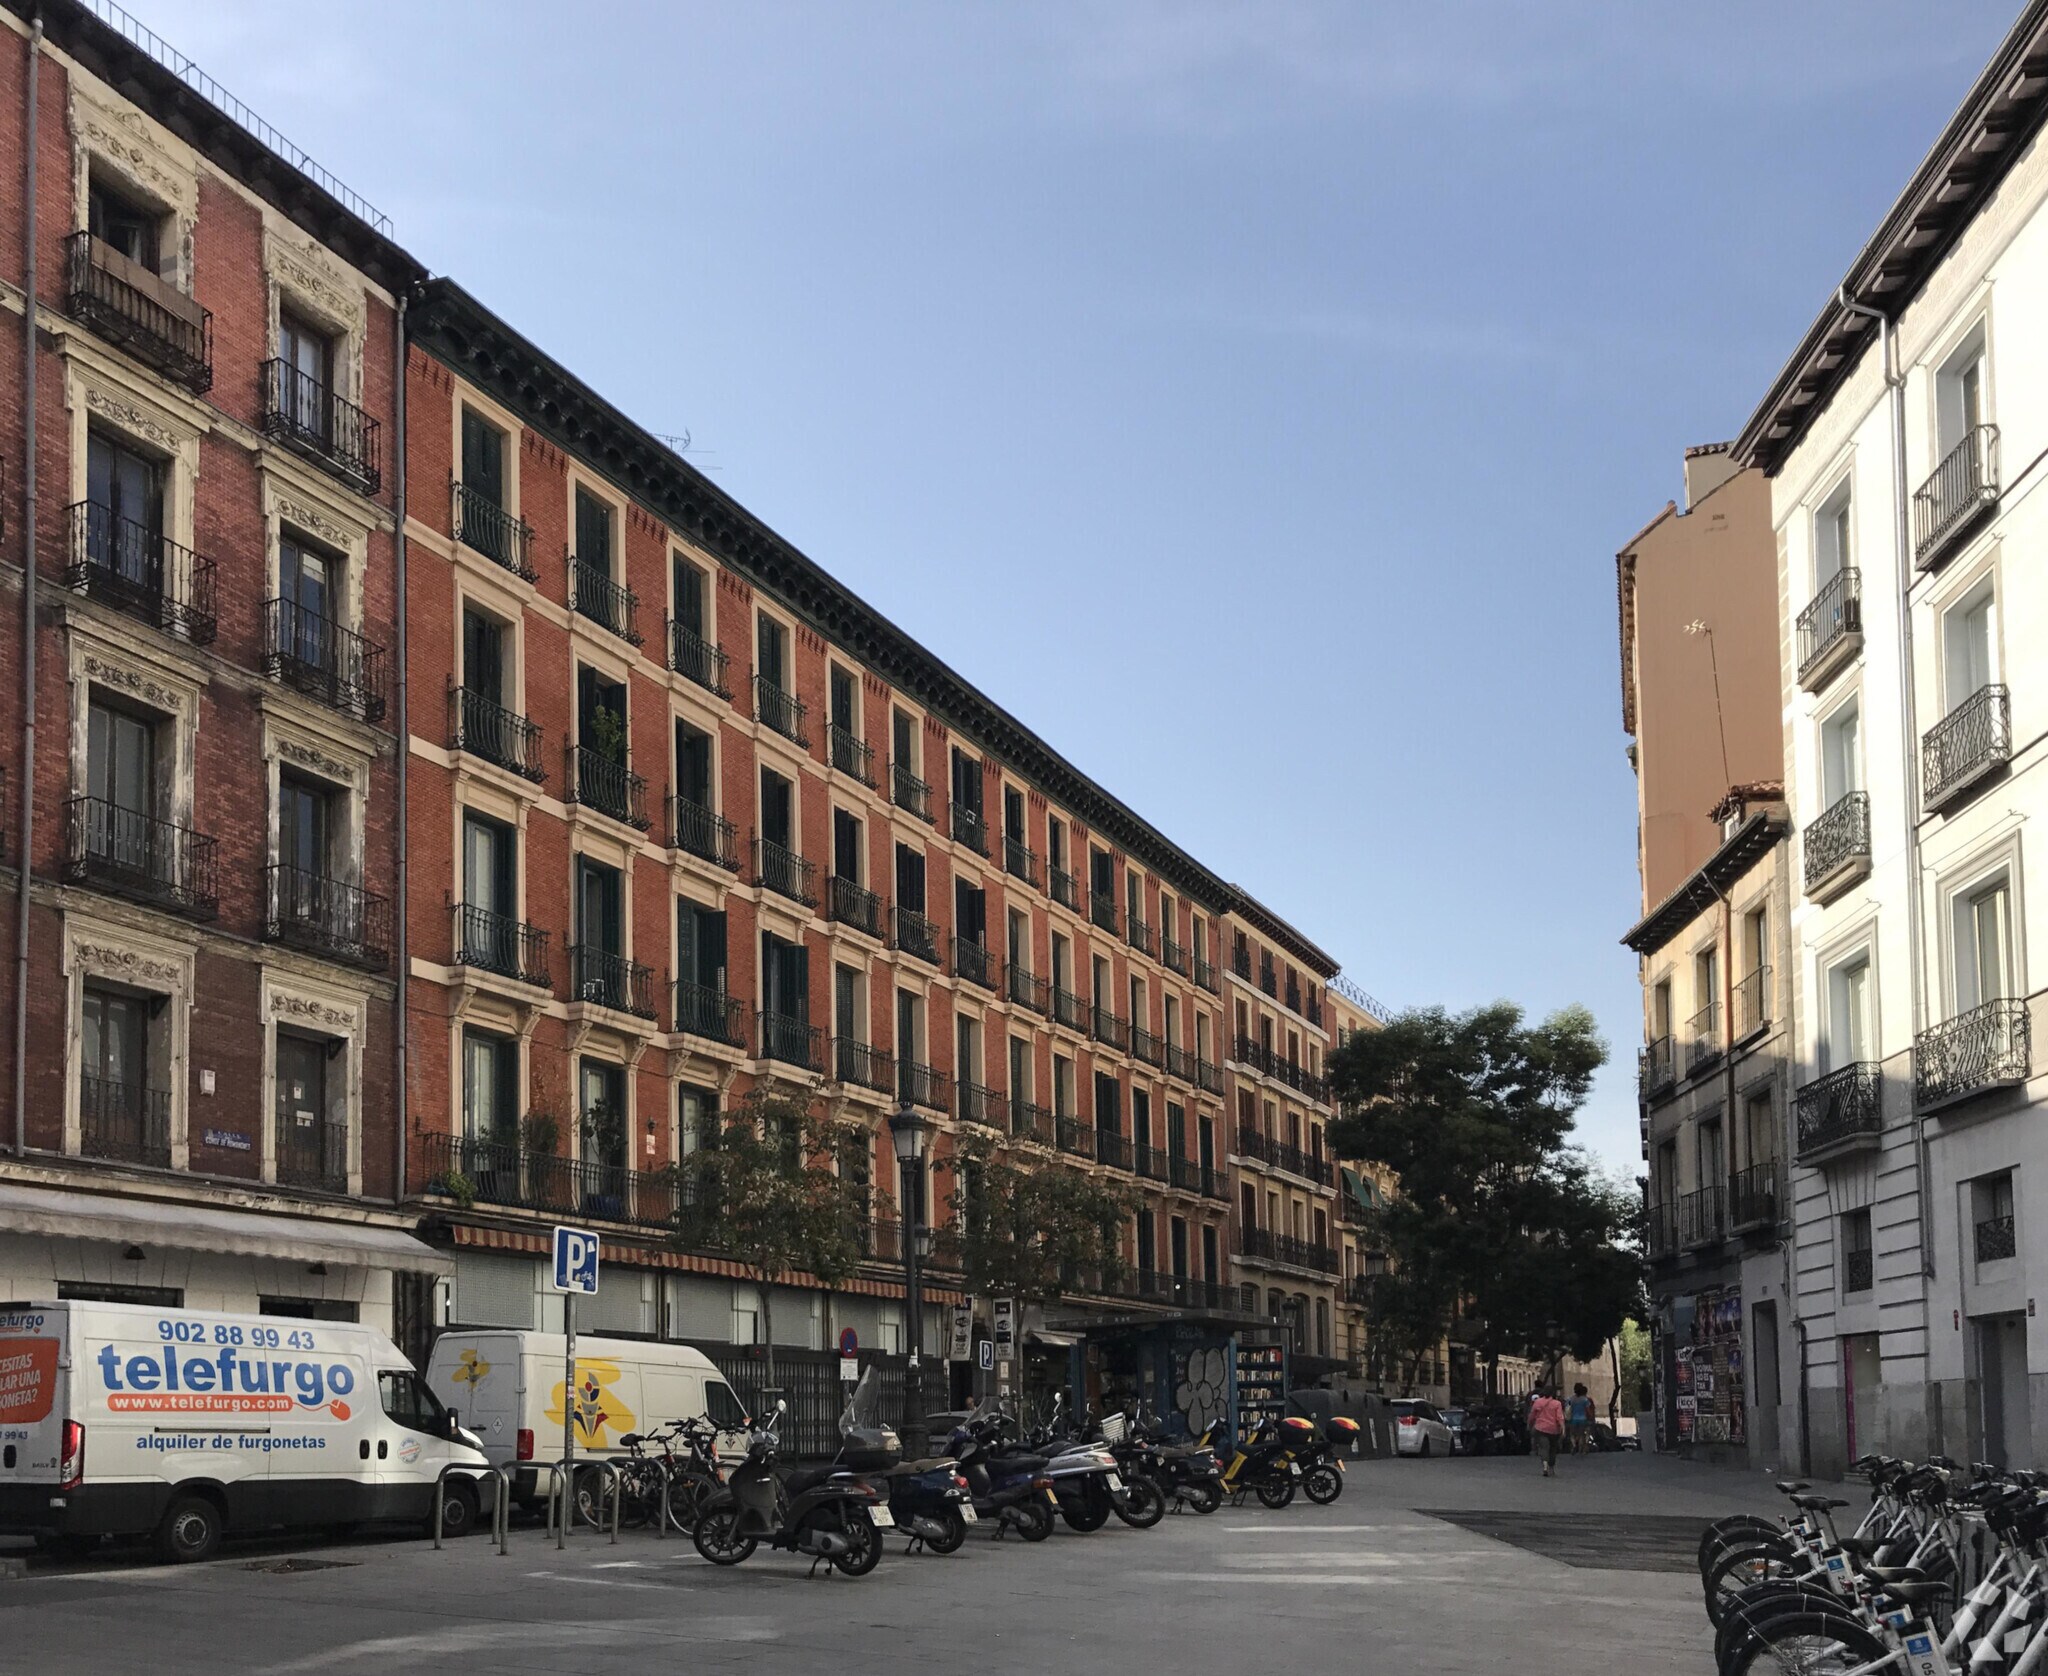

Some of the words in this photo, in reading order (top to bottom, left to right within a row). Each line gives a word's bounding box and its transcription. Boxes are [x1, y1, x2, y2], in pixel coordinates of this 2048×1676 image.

[566, 1234, 586, 1282] P
[158, 1320, 206, 1343] 902
[215, 1325, 244, 1345] 88
[251, 1327, 280, 1348] 99
[287, 1330, 315, 1350] 43
[984, 1344, 990, 1365] P
[18, 1369, 41, 1387] UNA
[97, 1343, 355, 1405] telefurgo
[114, 1396, 290, 1412] www.telefurgo.com
[17, 1431, 28, 1440] 43
[136, 1434, 207, 1452] alquiler
[212, 1434, 233, 1449] de
[238, 1434, 326, 1452] furgonetas
